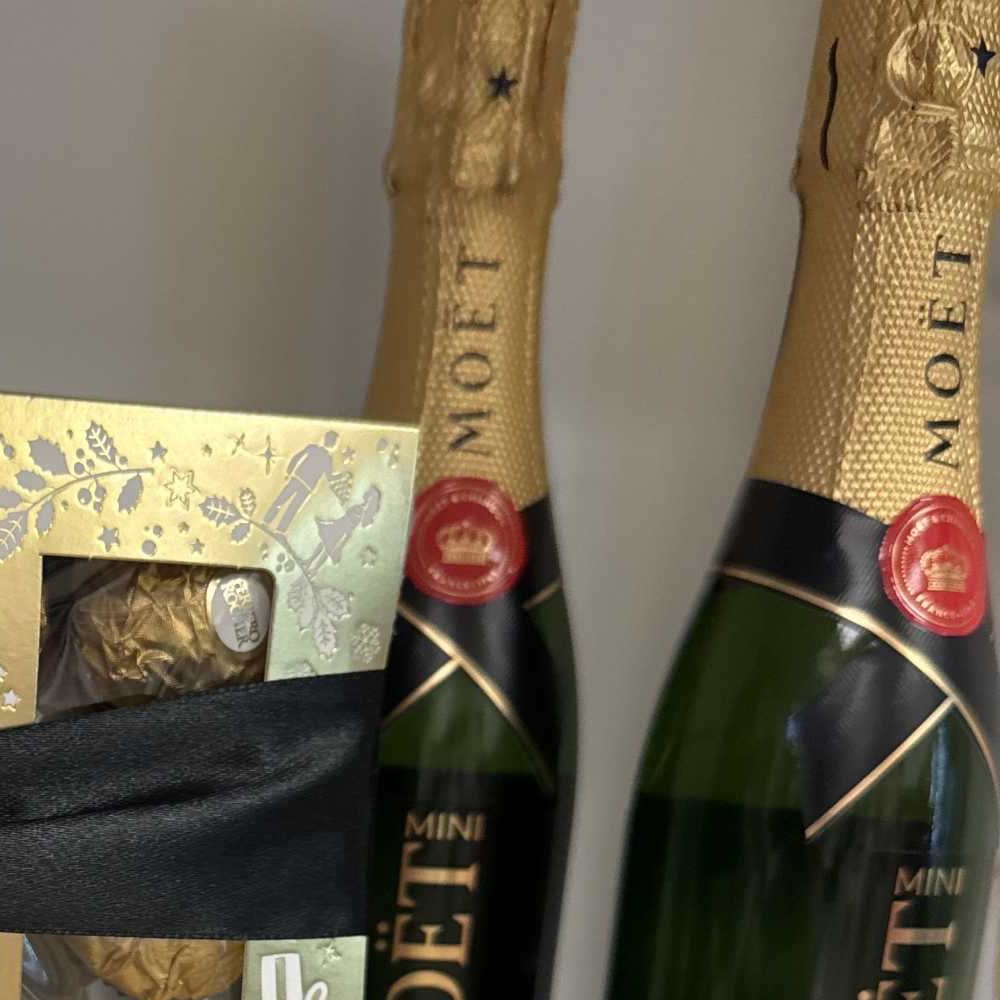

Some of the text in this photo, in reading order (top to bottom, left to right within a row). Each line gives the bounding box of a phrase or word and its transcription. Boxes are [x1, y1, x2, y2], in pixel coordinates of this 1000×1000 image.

[919, 234, 971, 468] MOËT
[404, 812, 487, 841] MINI
[894, 867, 966, 896] MINI
